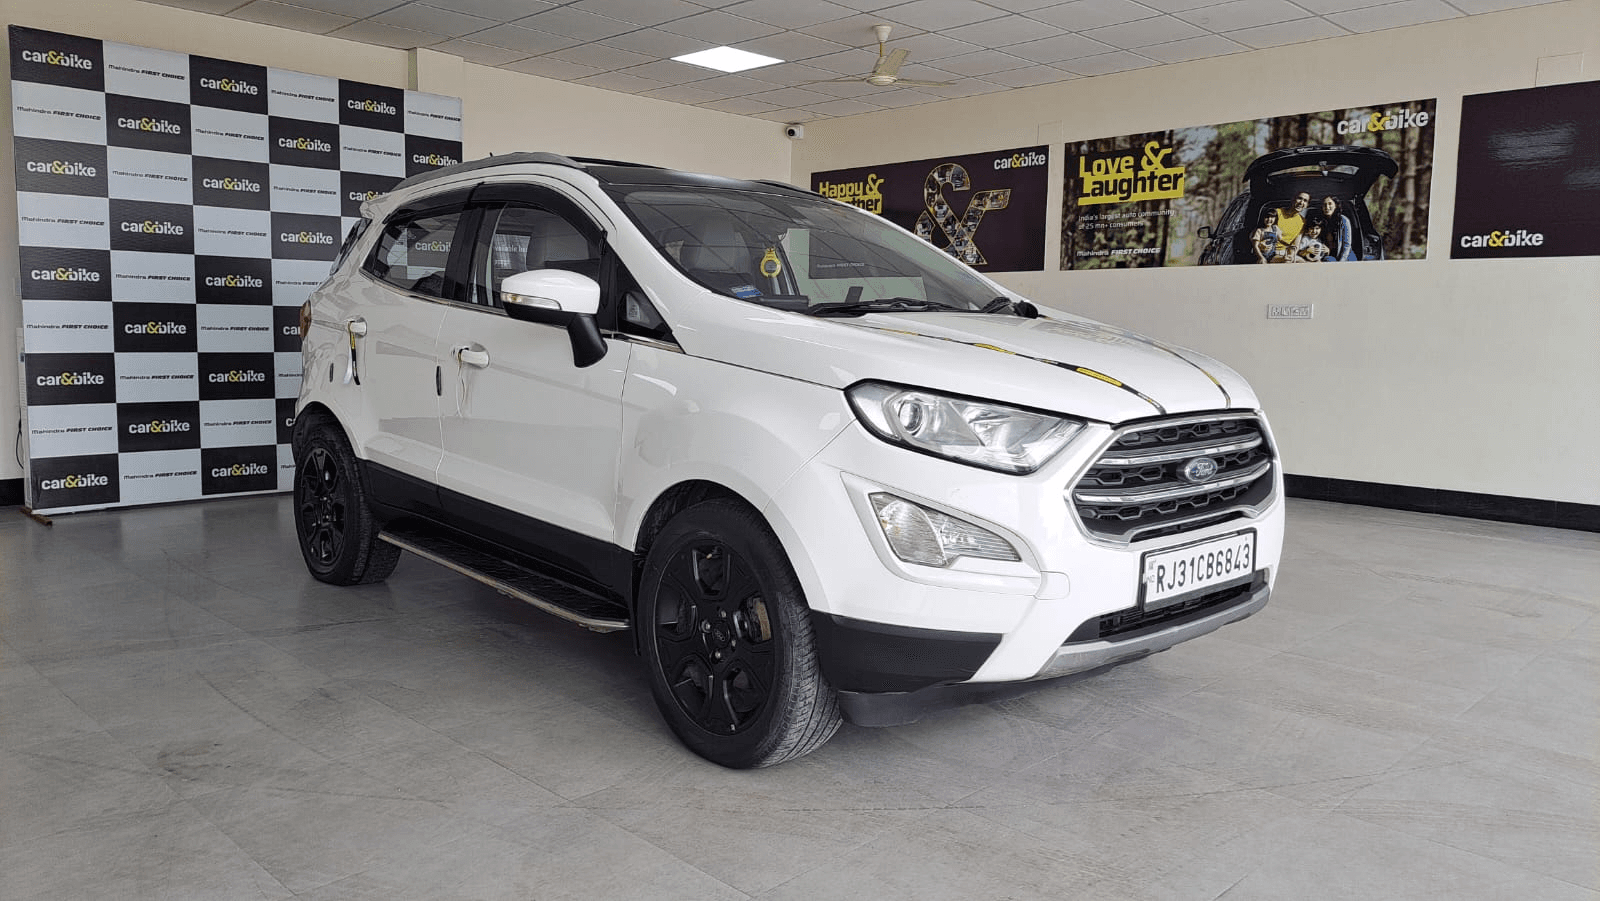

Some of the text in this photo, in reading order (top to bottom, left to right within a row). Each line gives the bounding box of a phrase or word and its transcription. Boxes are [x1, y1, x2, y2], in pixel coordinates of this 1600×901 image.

[22, 50, 93, 70] car&bike
[141, 69, 161, 78] FIRST
[161, 72, 185, 80] CHOICE
[200, 76, 258, 96] car&bike
[347, 99, 396, 115] car&bike
[53, 110, 74, 118] FIRST
[75, 113, 102, 121] CHOICE
[1336, 108, 1429, 136] car&bike
[117, 117, 181, 135] car&bike
[278, 136, 331, 153] car&bike
[994, 151, 1046, 170] car&bike
[1079, 141, 1172, 178] Love &
[26, 160, 96, 177] car&bike
[203, 177, 260, 193] car&bike
[819, 173, 884, 200] Happy &
[1080, 171, 1184, 201] Laughter
[1121, 211, 1137, 219] auto
[121, 220, 184, 236] car&bike
[1085, 222, 1094, 230] 25
[280, 230, 334, 245] car&bike
[1460, 229, 1544, 248] car&bike
[415, 240, 451, 253] car&bi
[1076, 247, 1162, 257] Mahindra FIRST CHOICE
[31, 267, 101, 282] car&bike
[205, 274, 263, 288] car&bike
[124, 321, 187, 335] car&bike
[36, 372, 104, 386] car&bike
[208, 370, 265, 383] car&bike
[128, 420, 191, 434] car&bike
[211, 463, 268, 478] car&bike
[41, 473, 108, 490] car&bike
[1155, 543, 1251, 594] RJ31CB6843
